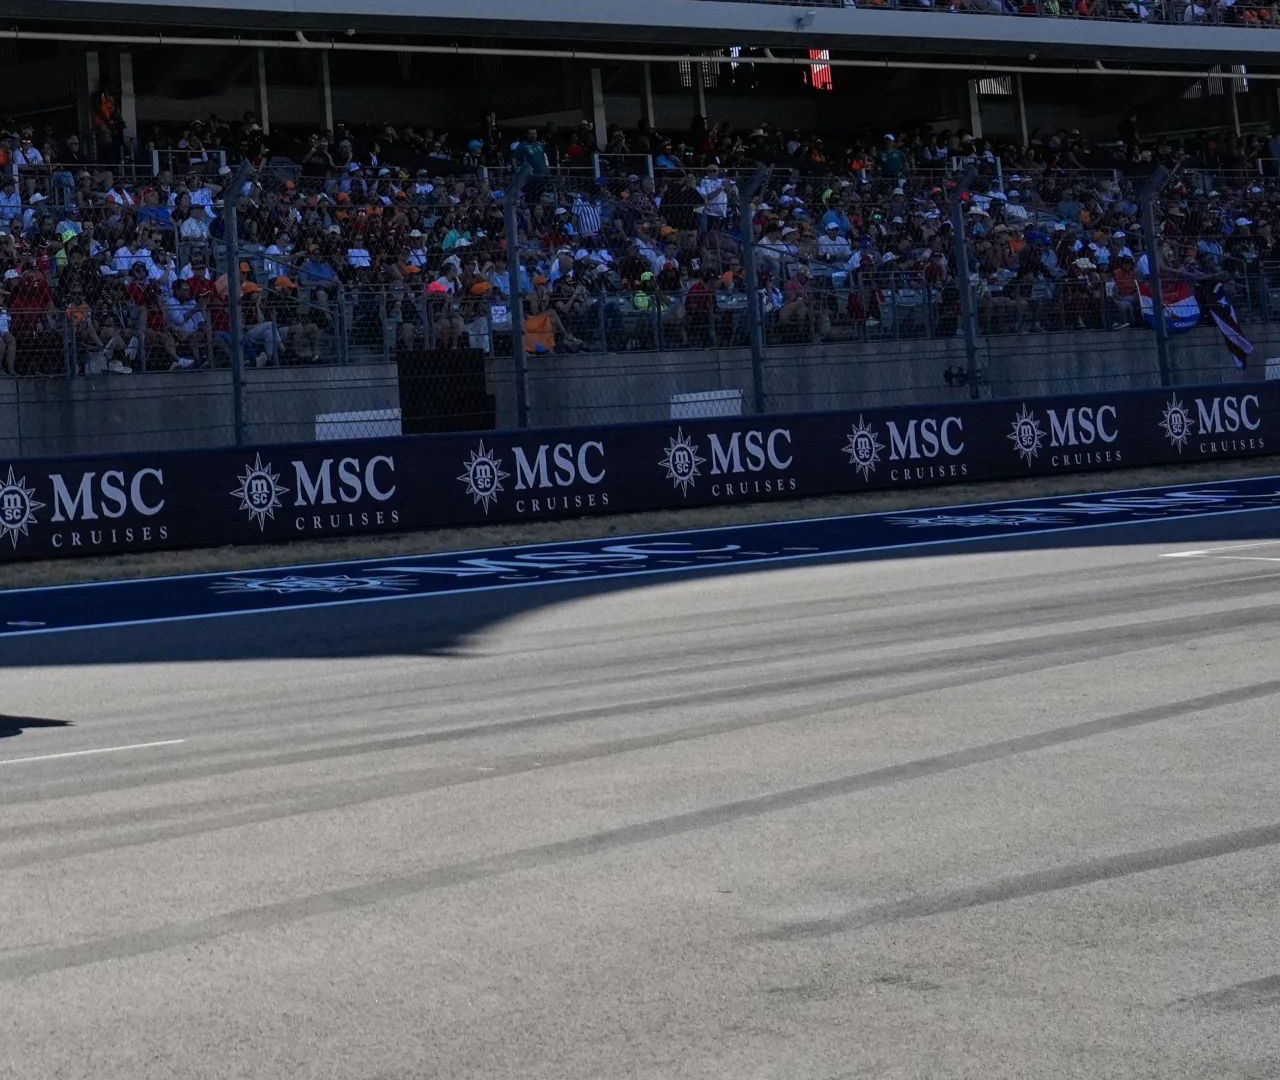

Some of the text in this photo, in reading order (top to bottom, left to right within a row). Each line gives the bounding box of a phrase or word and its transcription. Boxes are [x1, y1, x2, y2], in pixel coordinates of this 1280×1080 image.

[1047, 405, 1117, 446] MSC
[1194, 395, 1260, 434] MSC
[707, 429, 792, 474] MSC
[889, 417, 964, 460] MSC
[1200, 438, 1264, 453] CRUISES
[512, 441, 605, 489] MSC
[891, 464, 967, 480] CRUISES
[1052, 451, 1121, 466] CRUISES
[49, 468, 164, 521] MSC
[291, 456, 395, 506] MSC
[712, 479, 795, 496] CRUISES
[517, 493, 608, 512] CRUISES
[296, 511, 398, 530] CRUISES
[52, 526, 167, 547] CRUISES
